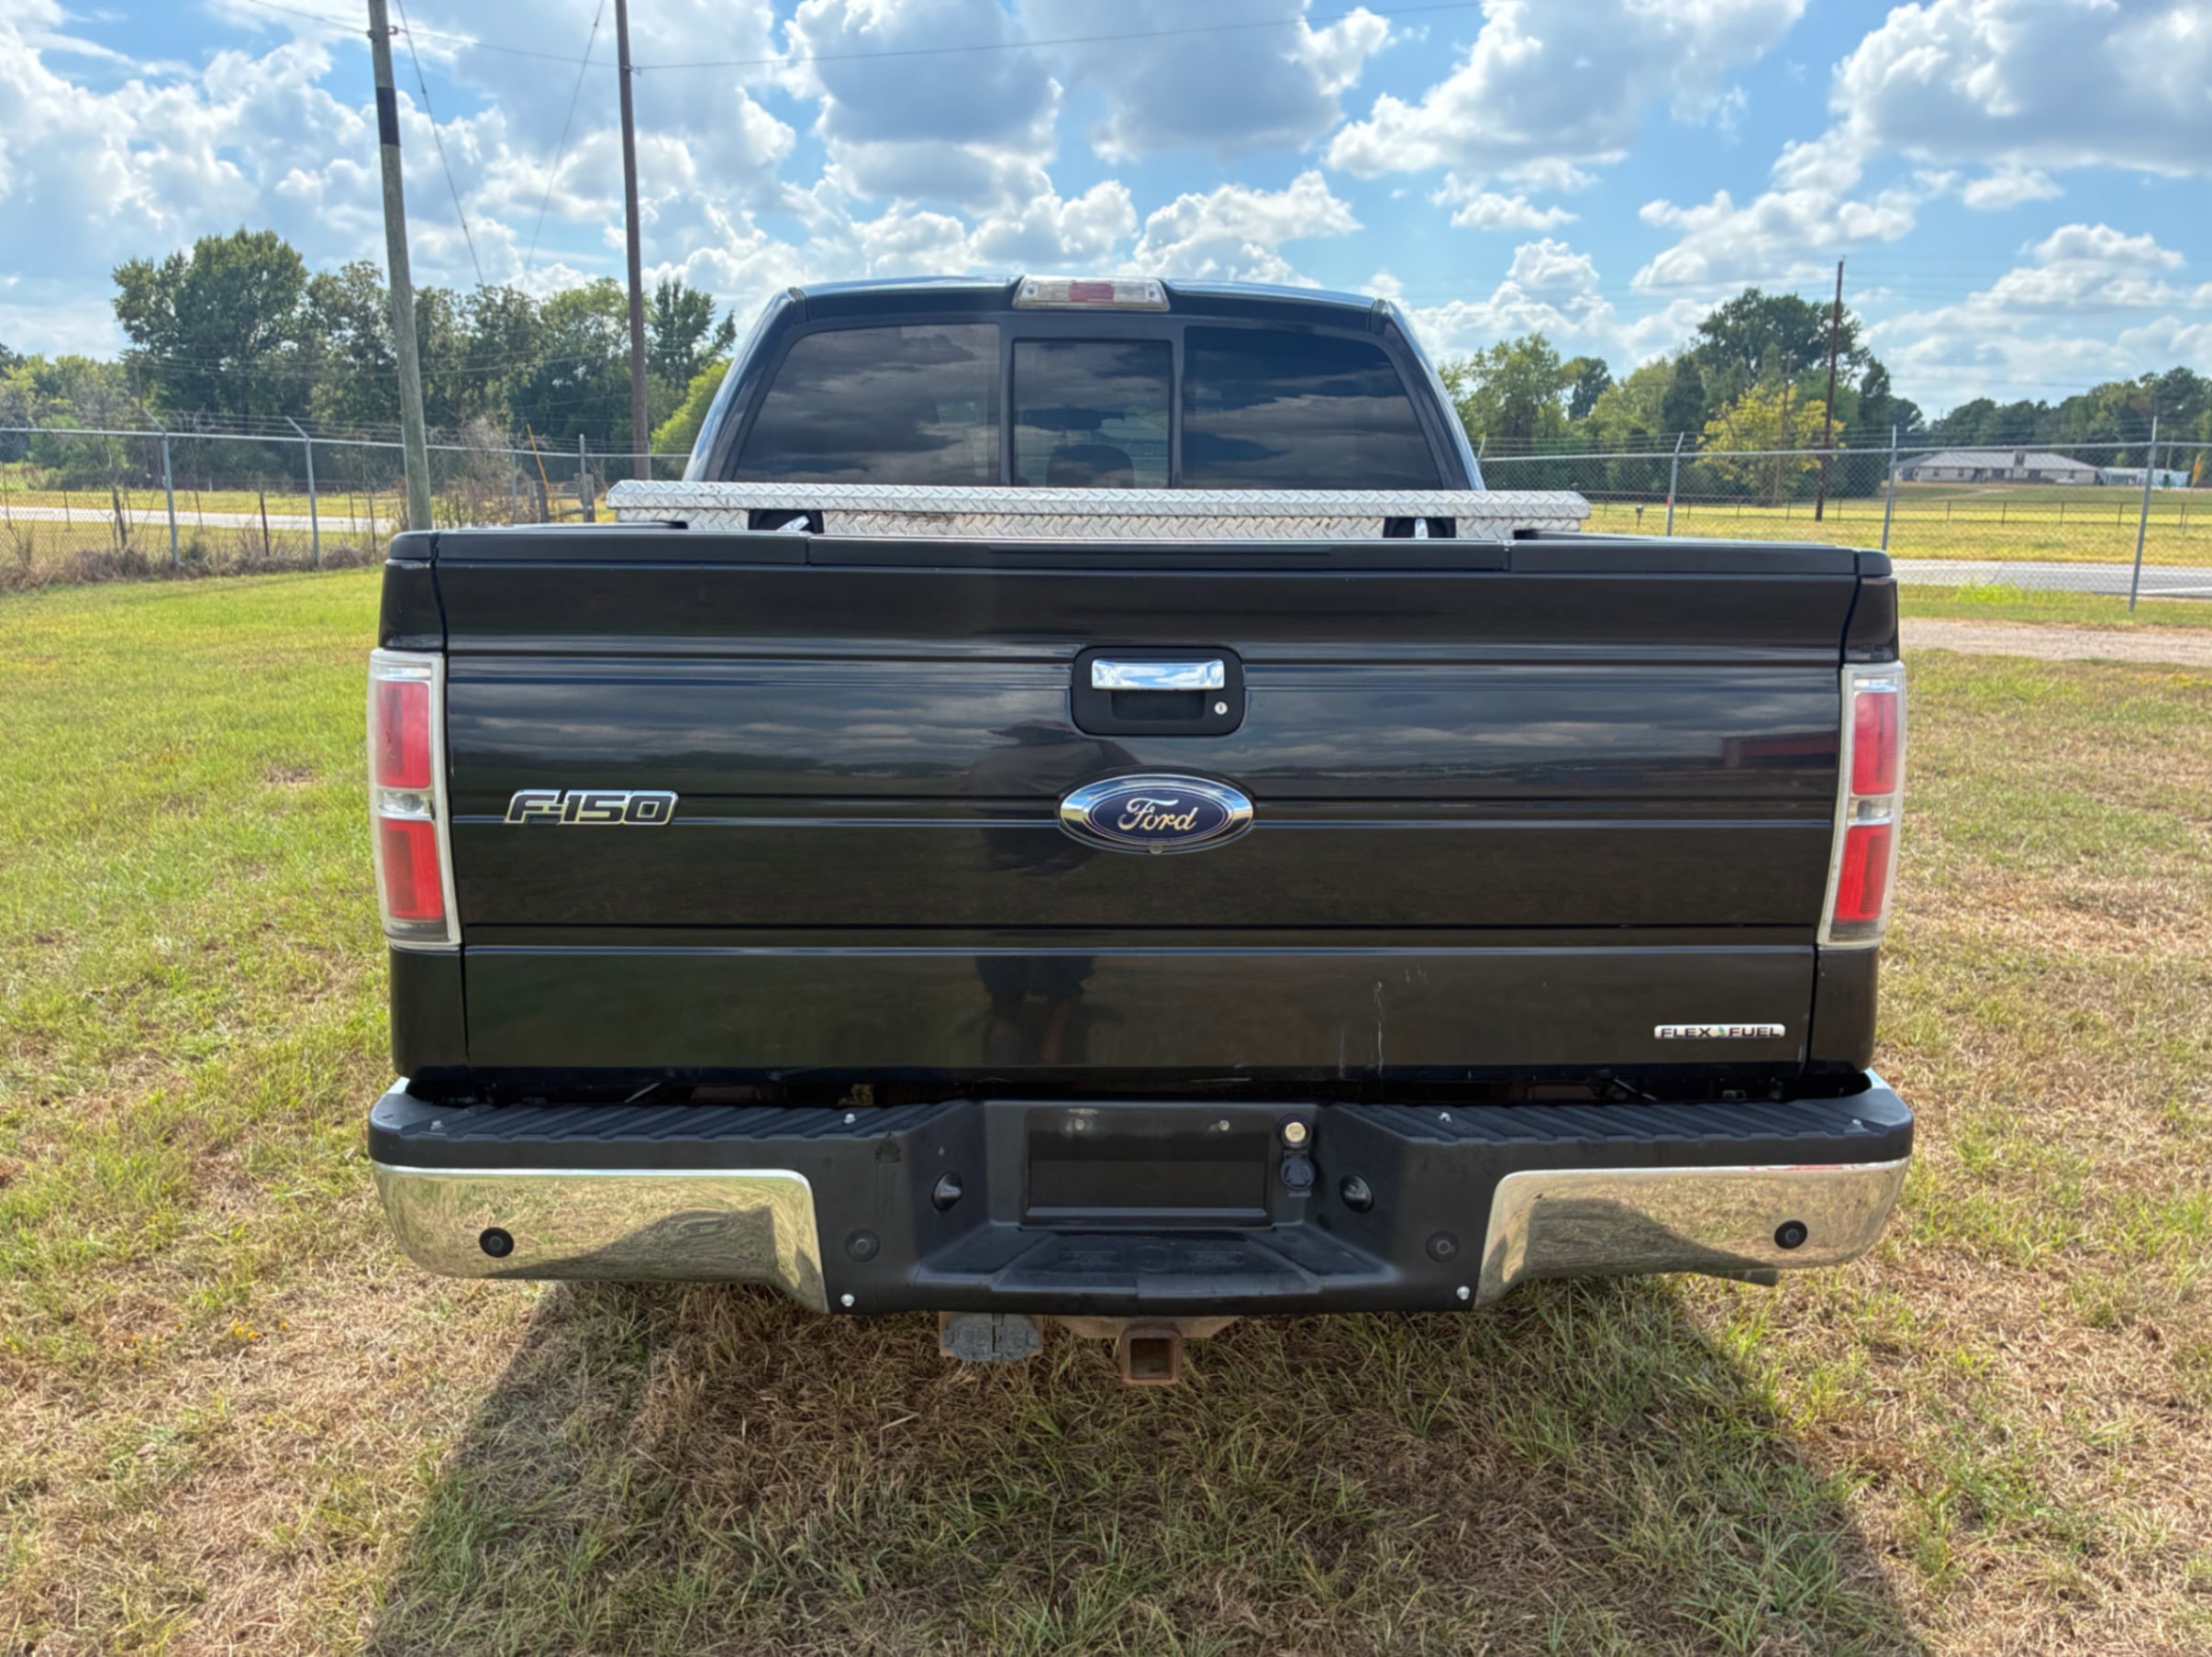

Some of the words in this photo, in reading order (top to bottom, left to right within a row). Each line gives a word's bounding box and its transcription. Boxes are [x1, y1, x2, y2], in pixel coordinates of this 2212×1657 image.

[1117, 796, 1199, 830] Ford
[1661, 1027, 1712, 1039] FLEX
[1728, 1026, 1781, 1038] FUEL
